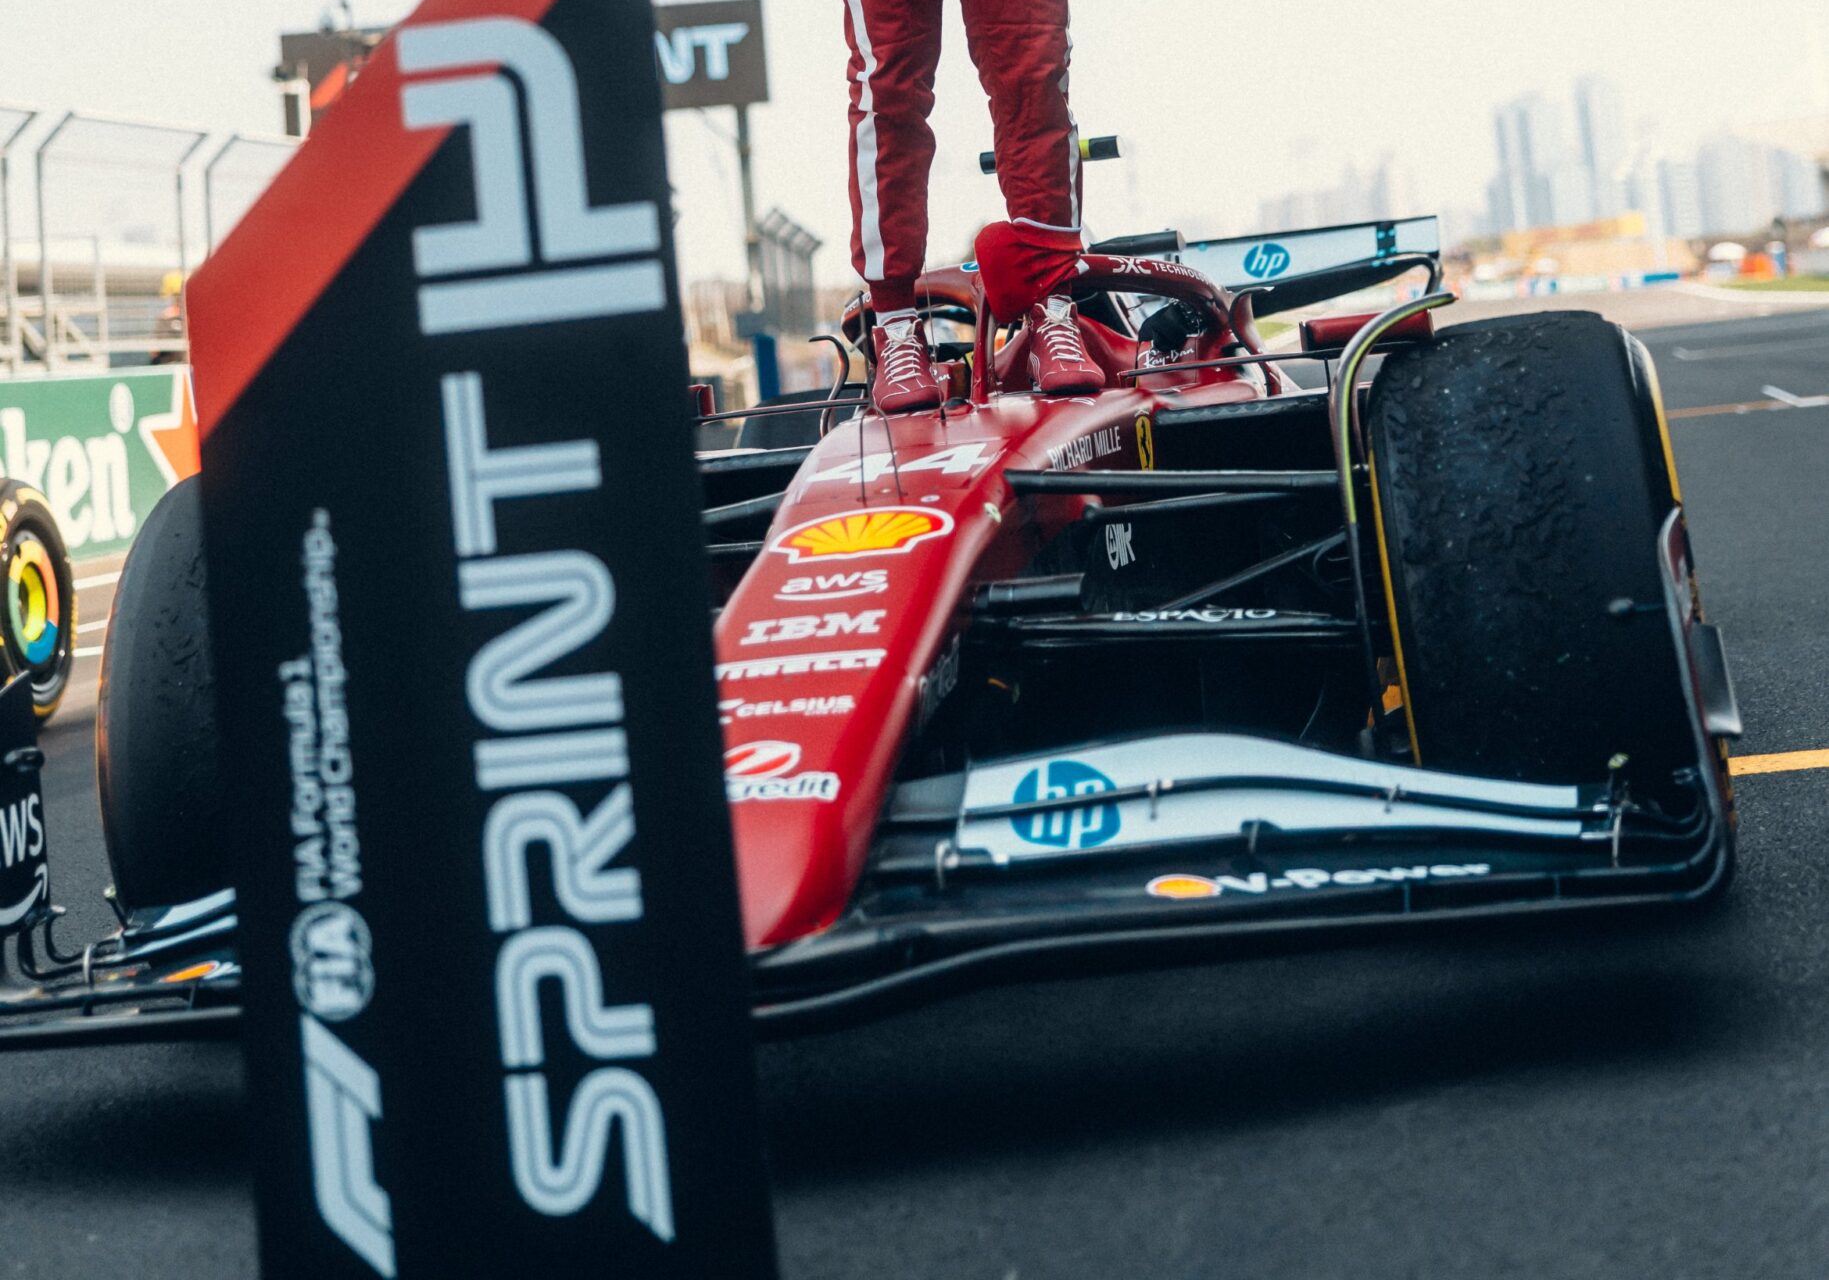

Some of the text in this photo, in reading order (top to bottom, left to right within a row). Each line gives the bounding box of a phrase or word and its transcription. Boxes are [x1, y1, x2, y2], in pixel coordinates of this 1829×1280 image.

[1107, 256, 1152, 275] DXC
[1248, 243, 1288, 278] hp
[805, 442, 992, 484] 44
[1047, 425, 1122, 471] RICHARD MILLE
[780, 569, 889, 593] aws
[739, 609, 887, 646] IBM
[735, 694, 856, 718] CELSIUS
[440, 370, 677, 1244] SPRINT
[1024, 761, 1113, 848] hp
